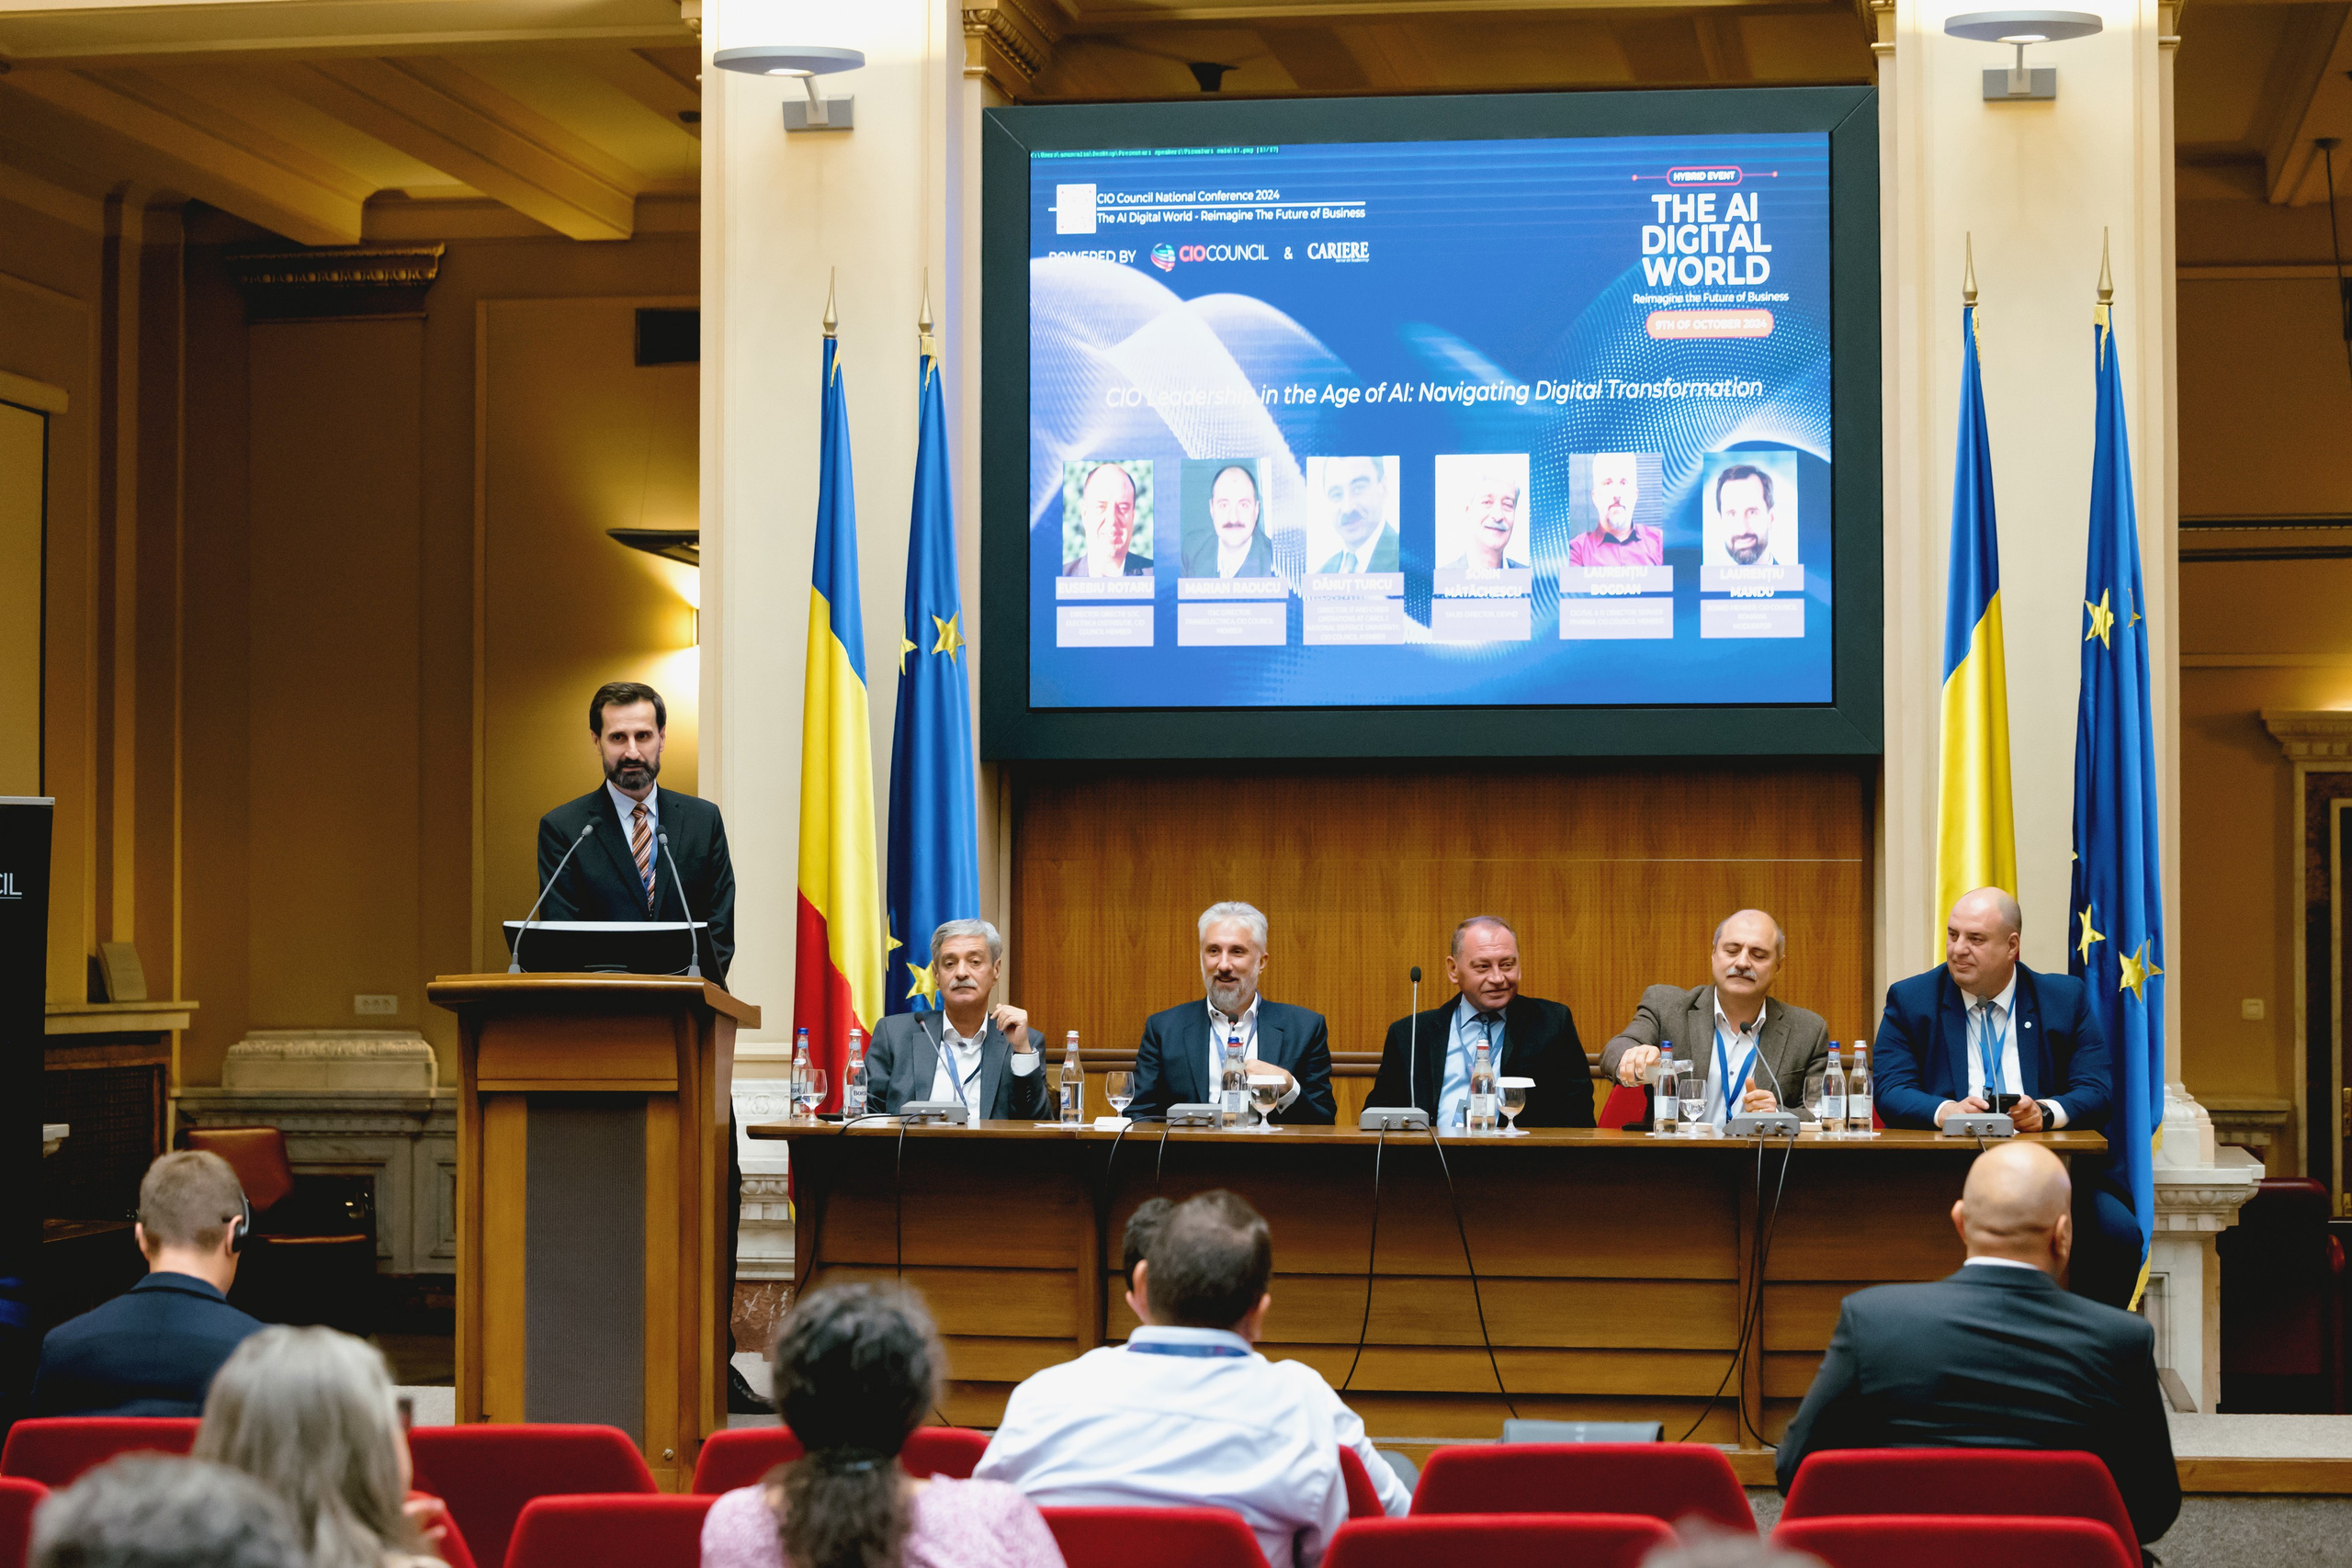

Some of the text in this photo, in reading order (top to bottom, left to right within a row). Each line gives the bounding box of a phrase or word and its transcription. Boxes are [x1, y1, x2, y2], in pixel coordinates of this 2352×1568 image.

[1673, 171, 1736, 181] HYBRID EVENT
[1097, 189, 1281, 204] CIO Council National Conference 2024
[1651, 192, 1758, 223] THE AI
[1097, 212, 1115, 223] The
[1117, 212, 1126, 223] AI
[1129, 211, 1160, 225] Digital
[1162, 210, 1193, 222] World
[1201, 209, 1253, 223] Reimagine
[1255, 209, 1273, 220] The
[1275, 209, 1308, 220] Future
[1310, 208, 1321, 219] of
[1322, 208, 1366, 219] Business
[1642, 223, 1772, 255] DIGITAL
[1048, 250, 1136, 264] POWERED BY
[1283, 246, 1293, 260] &
[1307, 242, 1370, 260] CARIERE
[1642, 254, 1770, 287] WORLD
[1633, 291, 1790, 307] Reimagine the Future of Business
[1655, 319, 1768, 331] 9TH OF OCTOBER 2024
[1105, 377, 1762, 410] CIO Leadership in the Age of AI: Navigating Digital Transformation
[1465, 568, 1500, 580] SORIN
[1107, 581, 1153, 593] ROTARU
[1185, 581, 1281, 593] MARIAN RADUCU
[1354, 579, 1393, 591] TURCU
[1590, 583, 1642, 595] BOGDAN
[1730, 585, 1774, 597] MANDU
